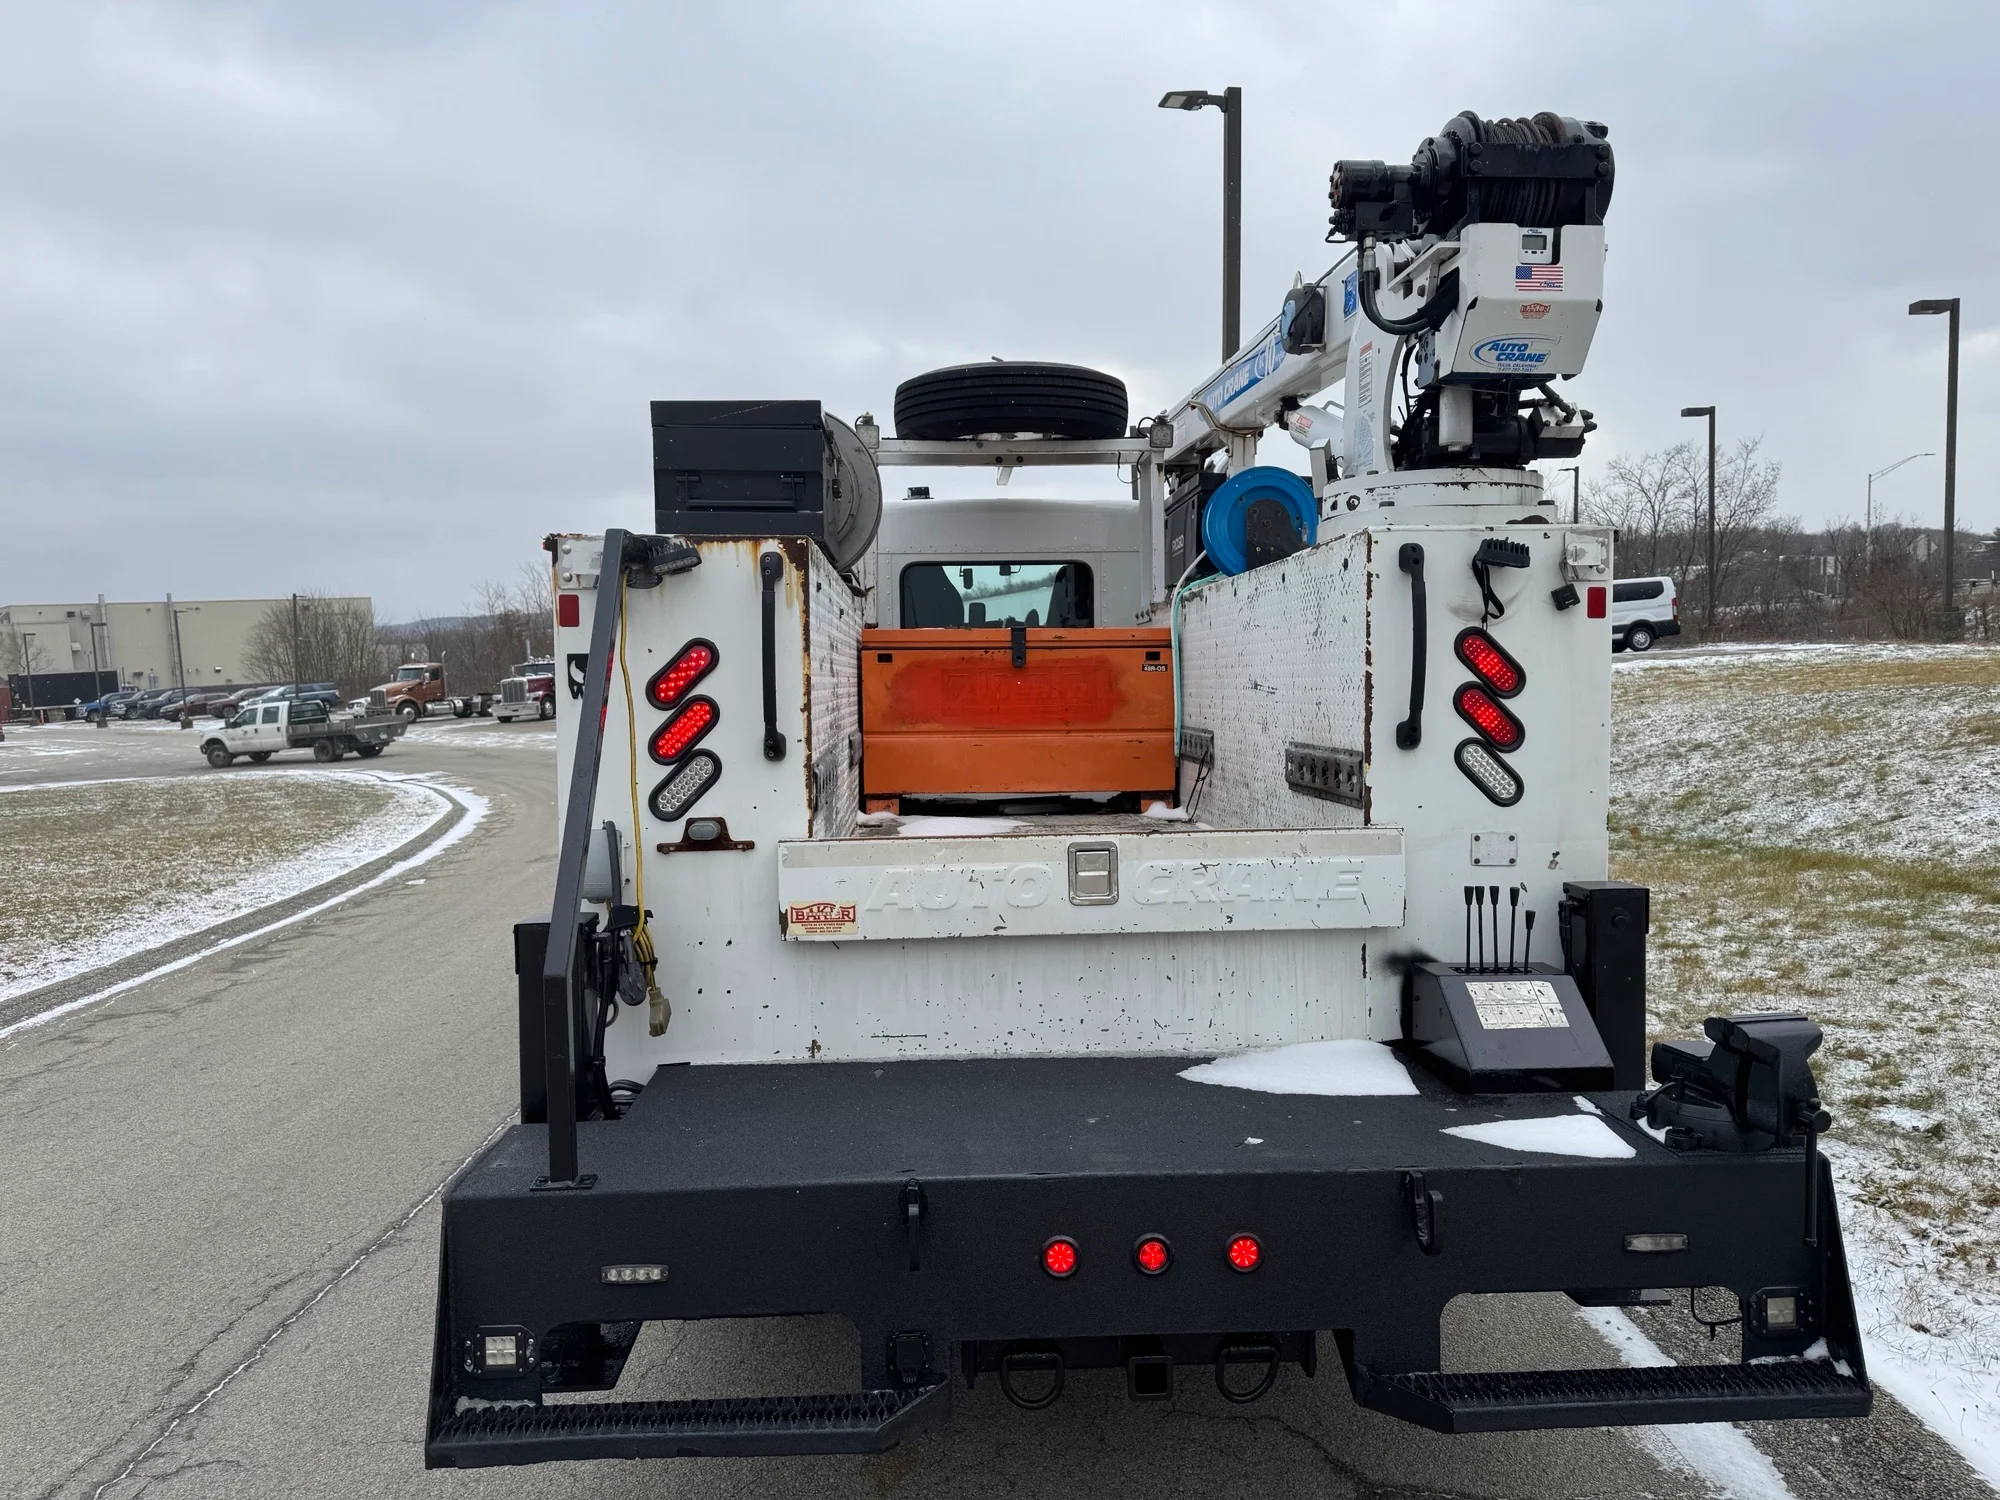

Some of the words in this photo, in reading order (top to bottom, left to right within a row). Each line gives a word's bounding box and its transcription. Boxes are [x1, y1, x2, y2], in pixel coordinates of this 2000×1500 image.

[1487, 342, 1529, 353] AUTO
[1495, 352, 1549, 363] CRANE
[1224, 363, 1250, 402] CRANE
[866, 864, 1051, 911] AUTO
[1133, 857, 1365, 906] CRANE
